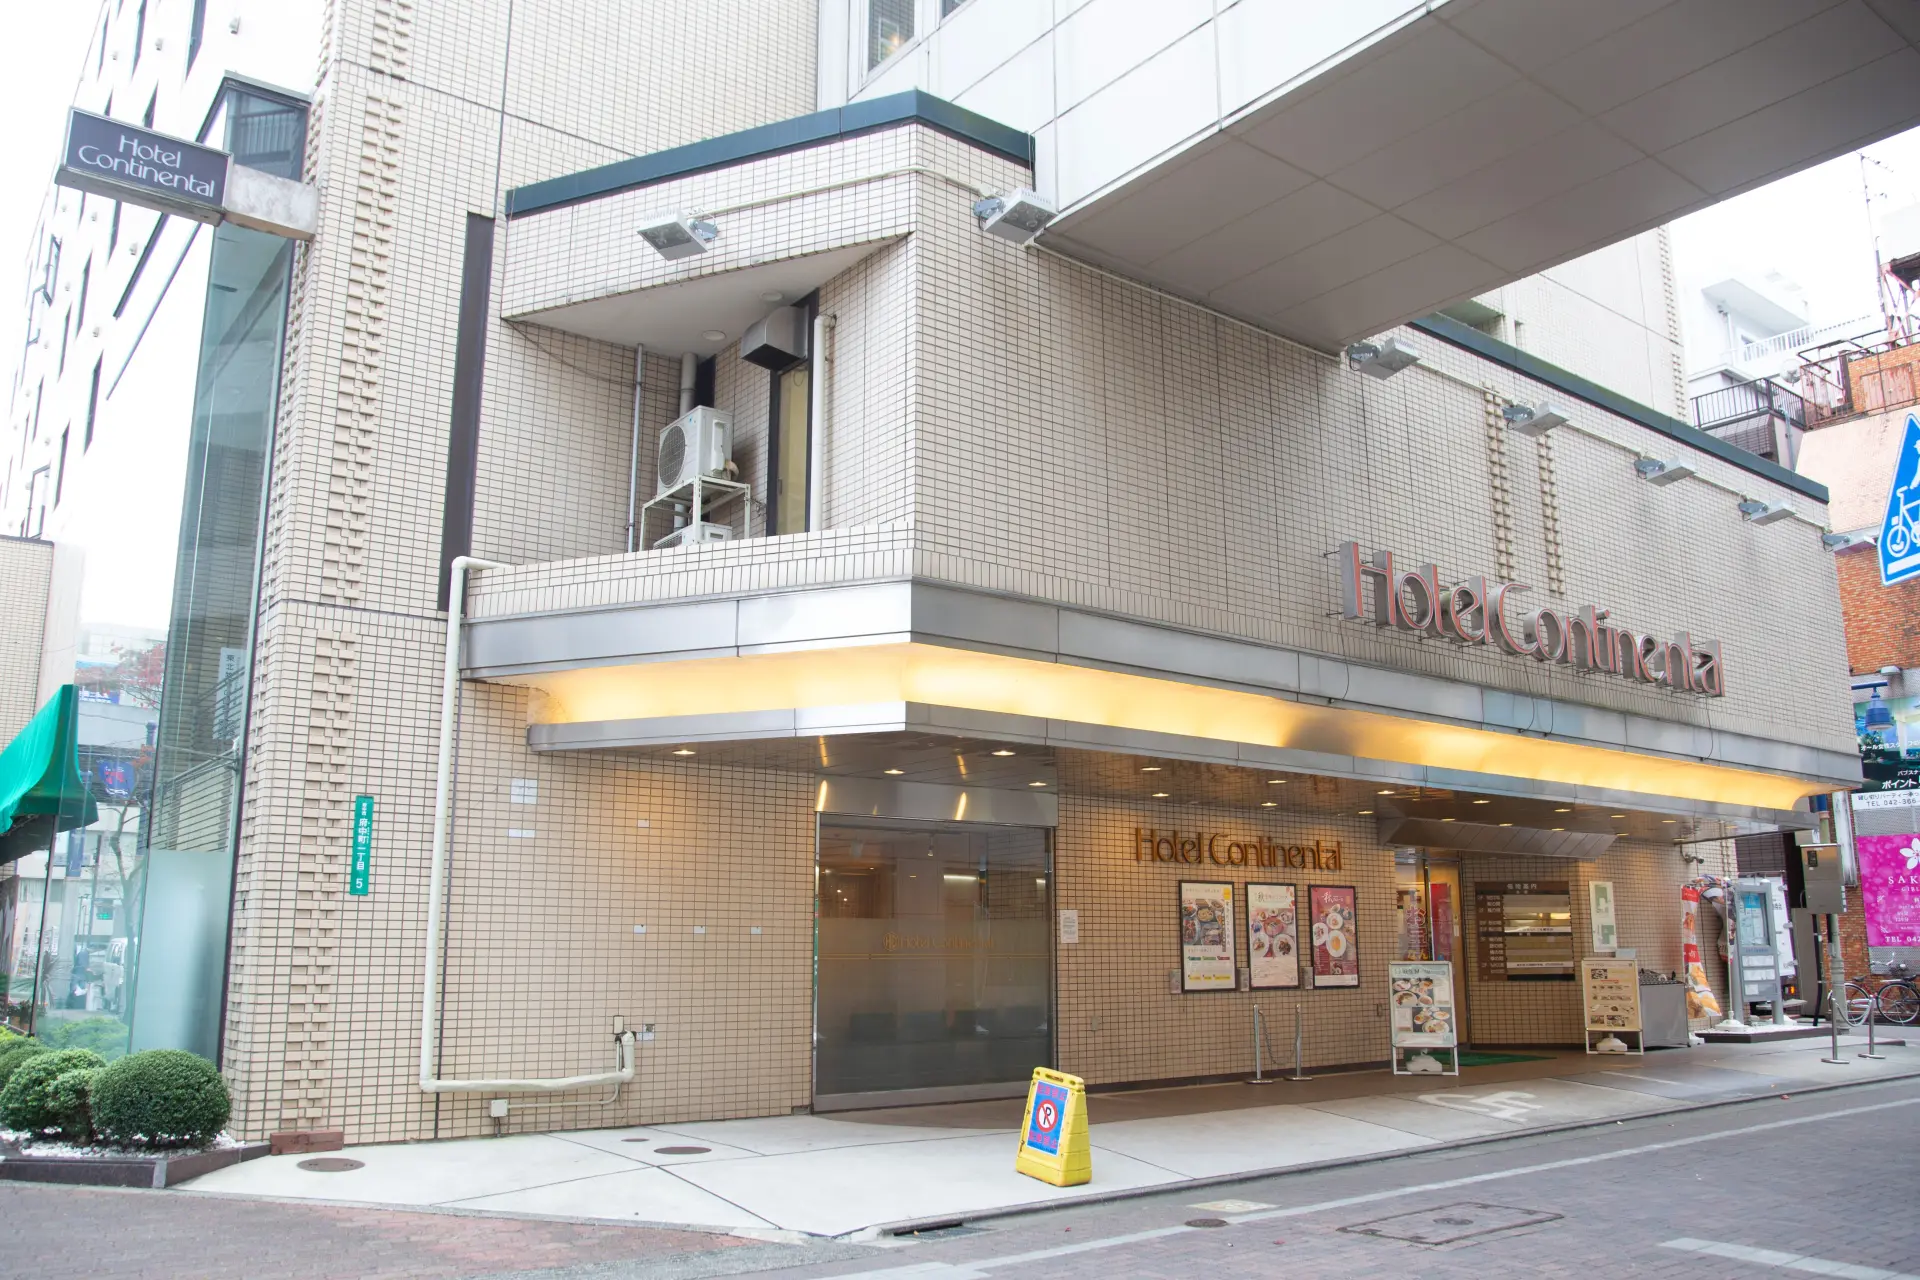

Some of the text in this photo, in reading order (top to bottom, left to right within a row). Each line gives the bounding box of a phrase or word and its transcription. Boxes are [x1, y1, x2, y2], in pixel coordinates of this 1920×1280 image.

[78, 145, 215, 198] Continental
[118, 134, 182, 169] Hotel
[1339, 540, 1726, 697] Hotel Continental
[1134, 827, 1342, 870] Hotel Continental
[355, 878, 363, 889] 5
